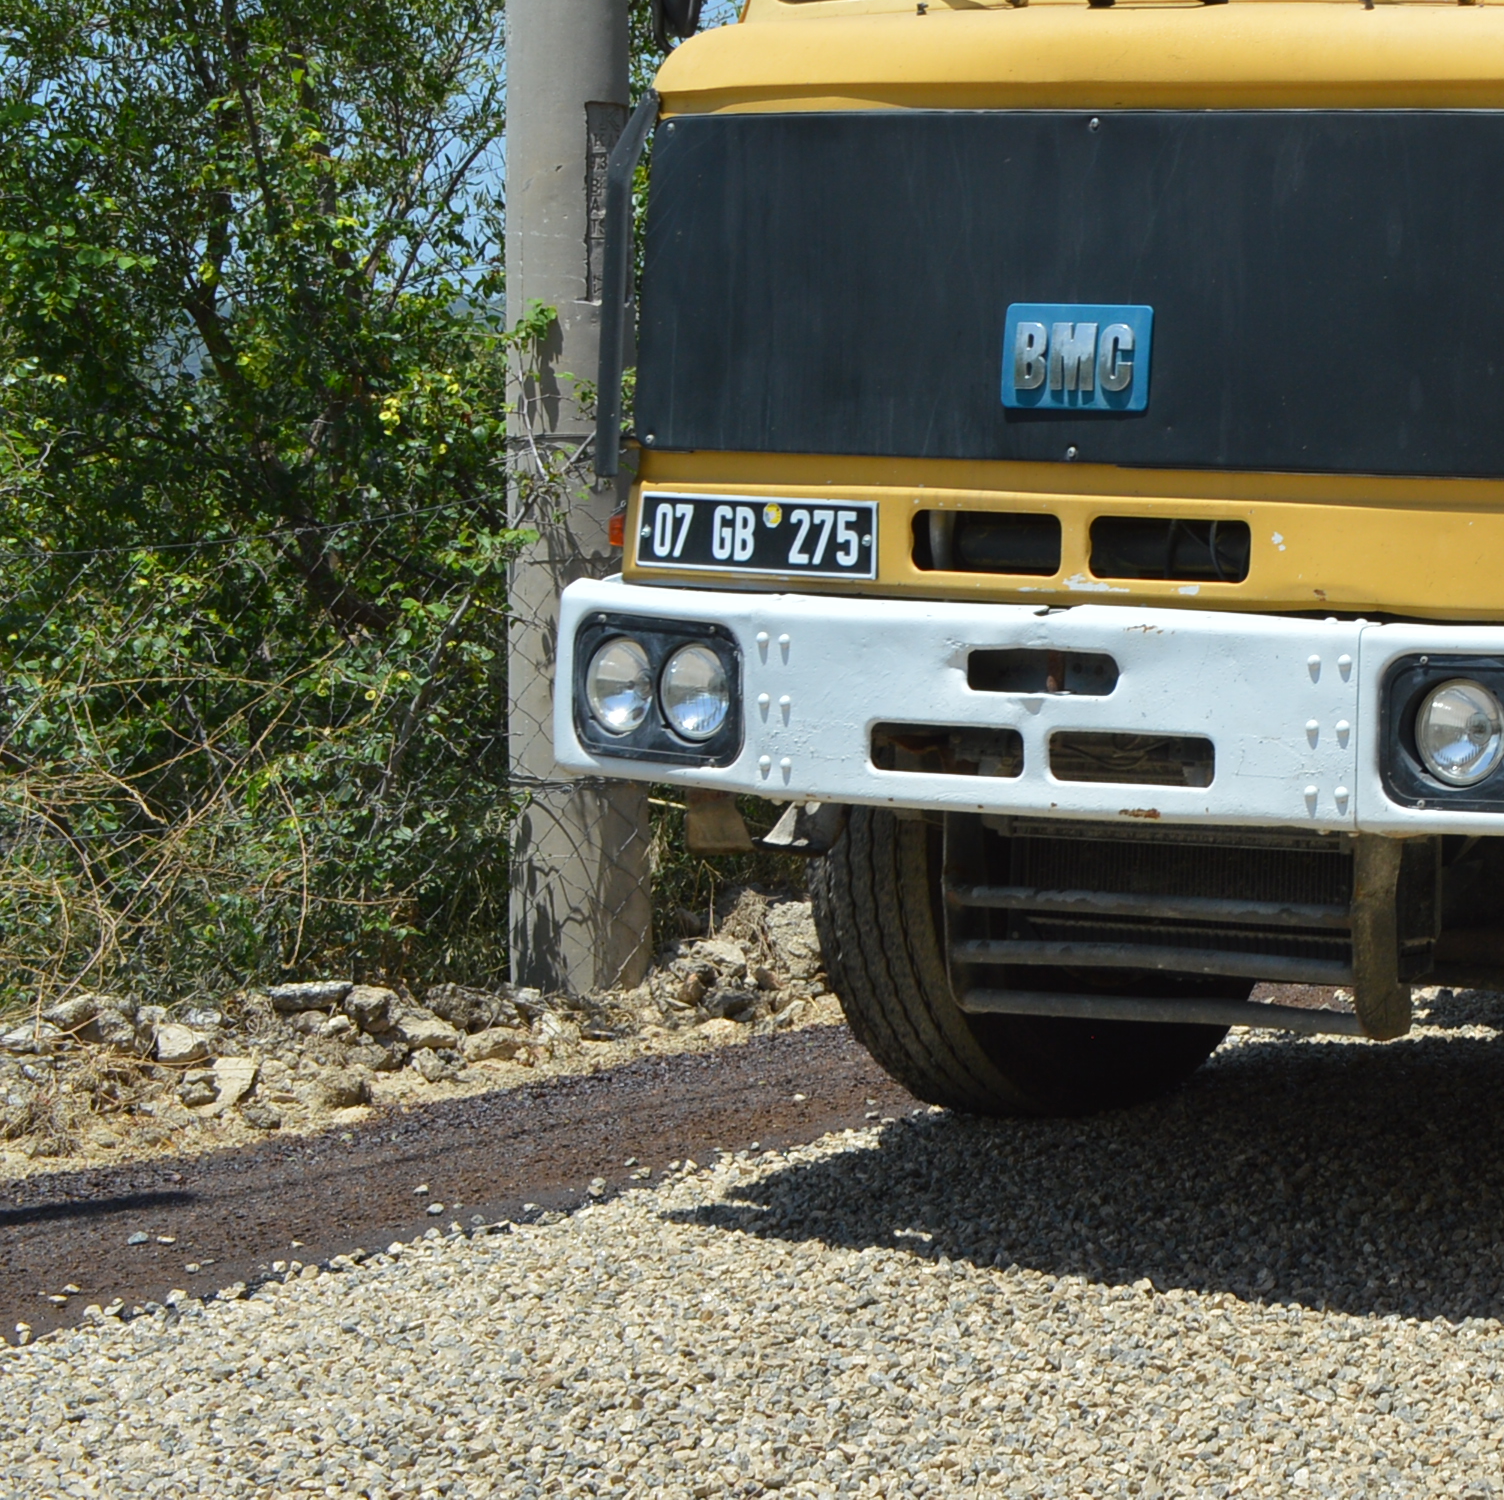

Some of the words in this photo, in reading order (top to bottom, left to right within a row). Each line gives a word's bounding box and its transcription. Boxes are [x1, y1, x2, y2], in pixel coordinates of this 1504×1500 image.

[1013, 321, 1135, 392] BMC
[653, 503, 694, 557] 07
[712, 505, 756, 561] GB
[788, 509, 859, 566] 275
